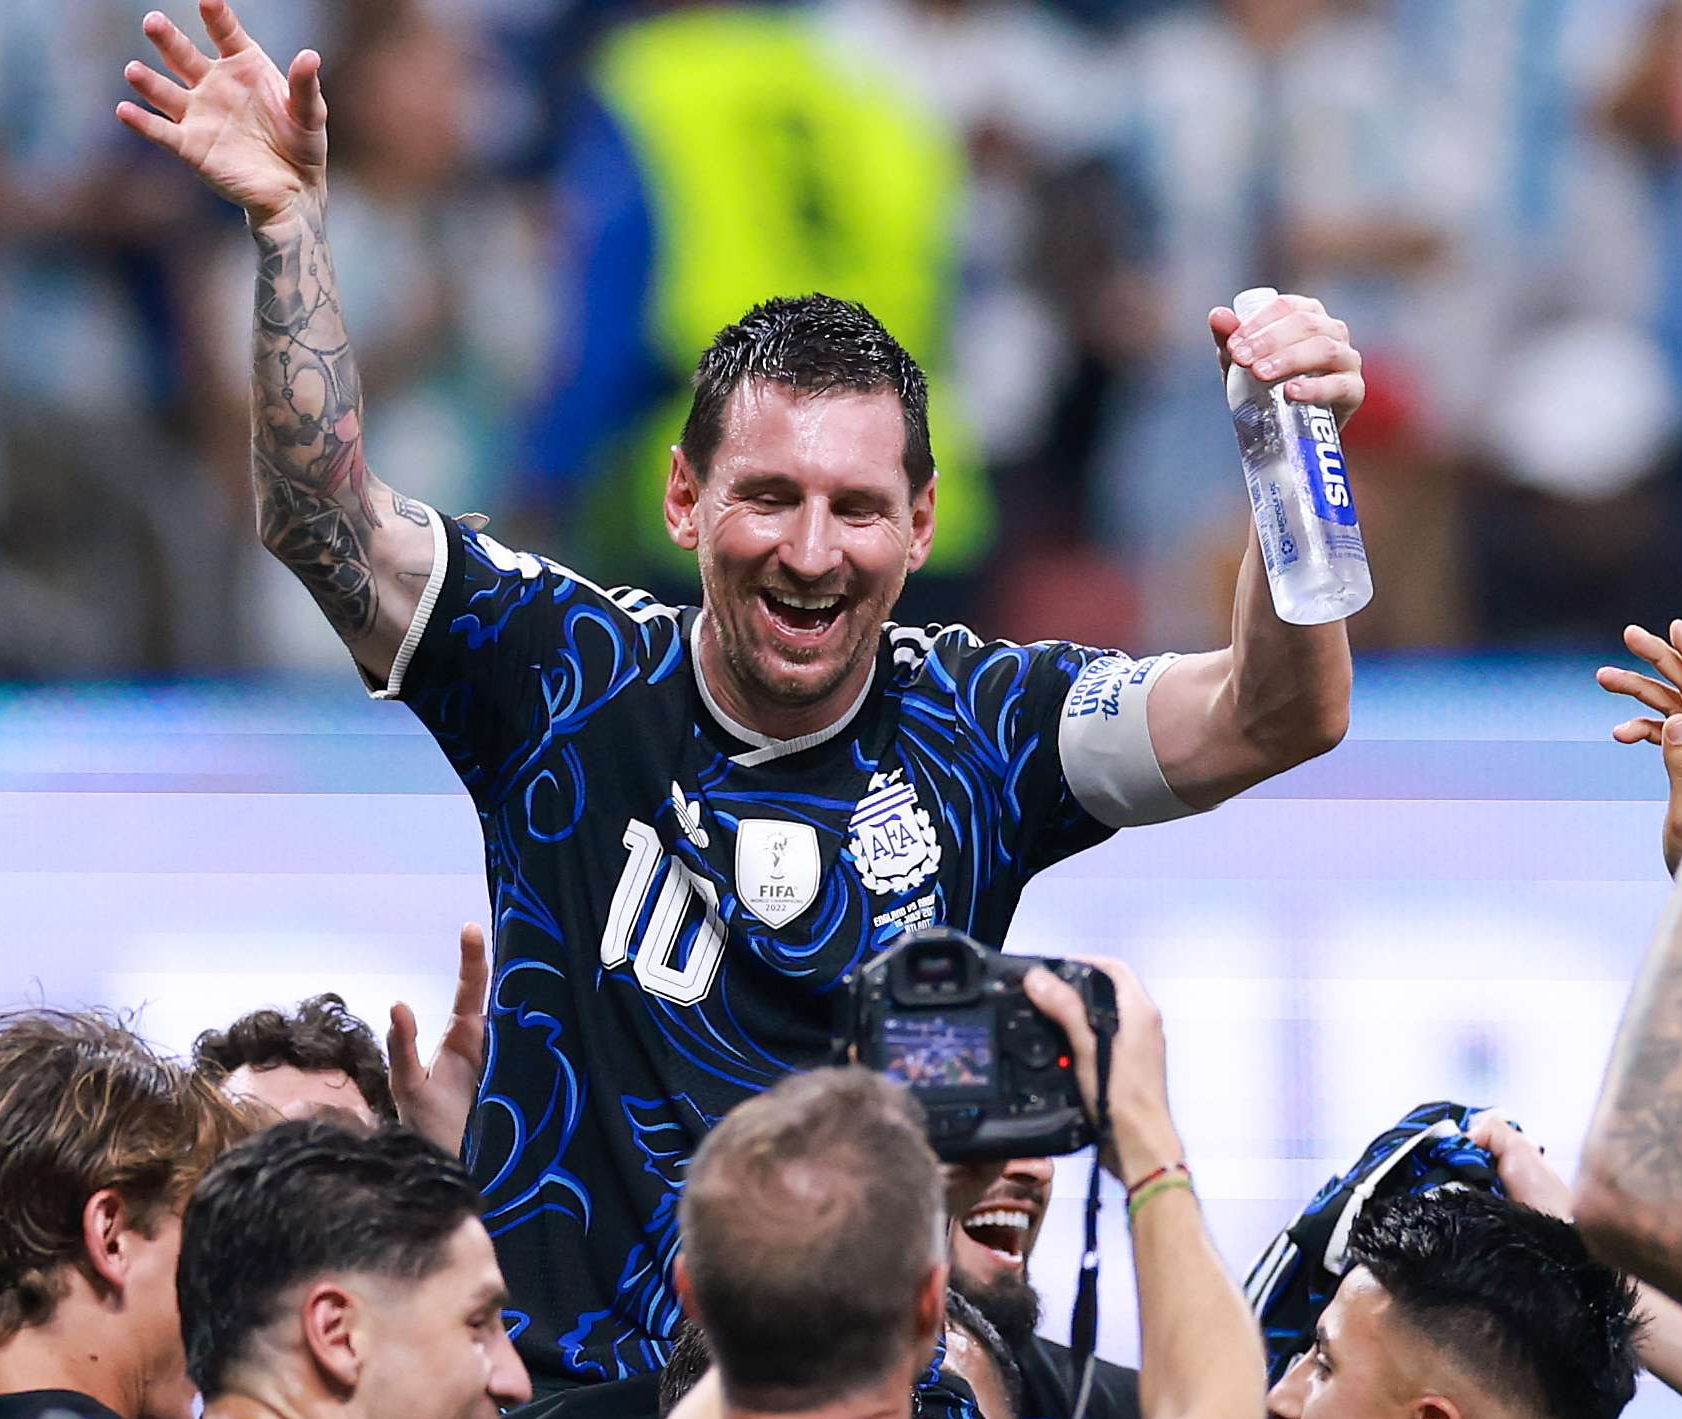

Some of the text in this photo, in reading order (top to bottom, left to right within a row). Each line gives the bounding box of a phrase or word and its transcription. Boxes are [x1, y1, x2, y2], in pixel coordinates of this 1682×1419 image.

[1101, 679, 1122, 720] the
[869, 813, 918, 861] AFA
[759, 885, 795, 898] FIFA
[765, 904, 787, 912] 2022
[598, 818, 729, 1007] 10
